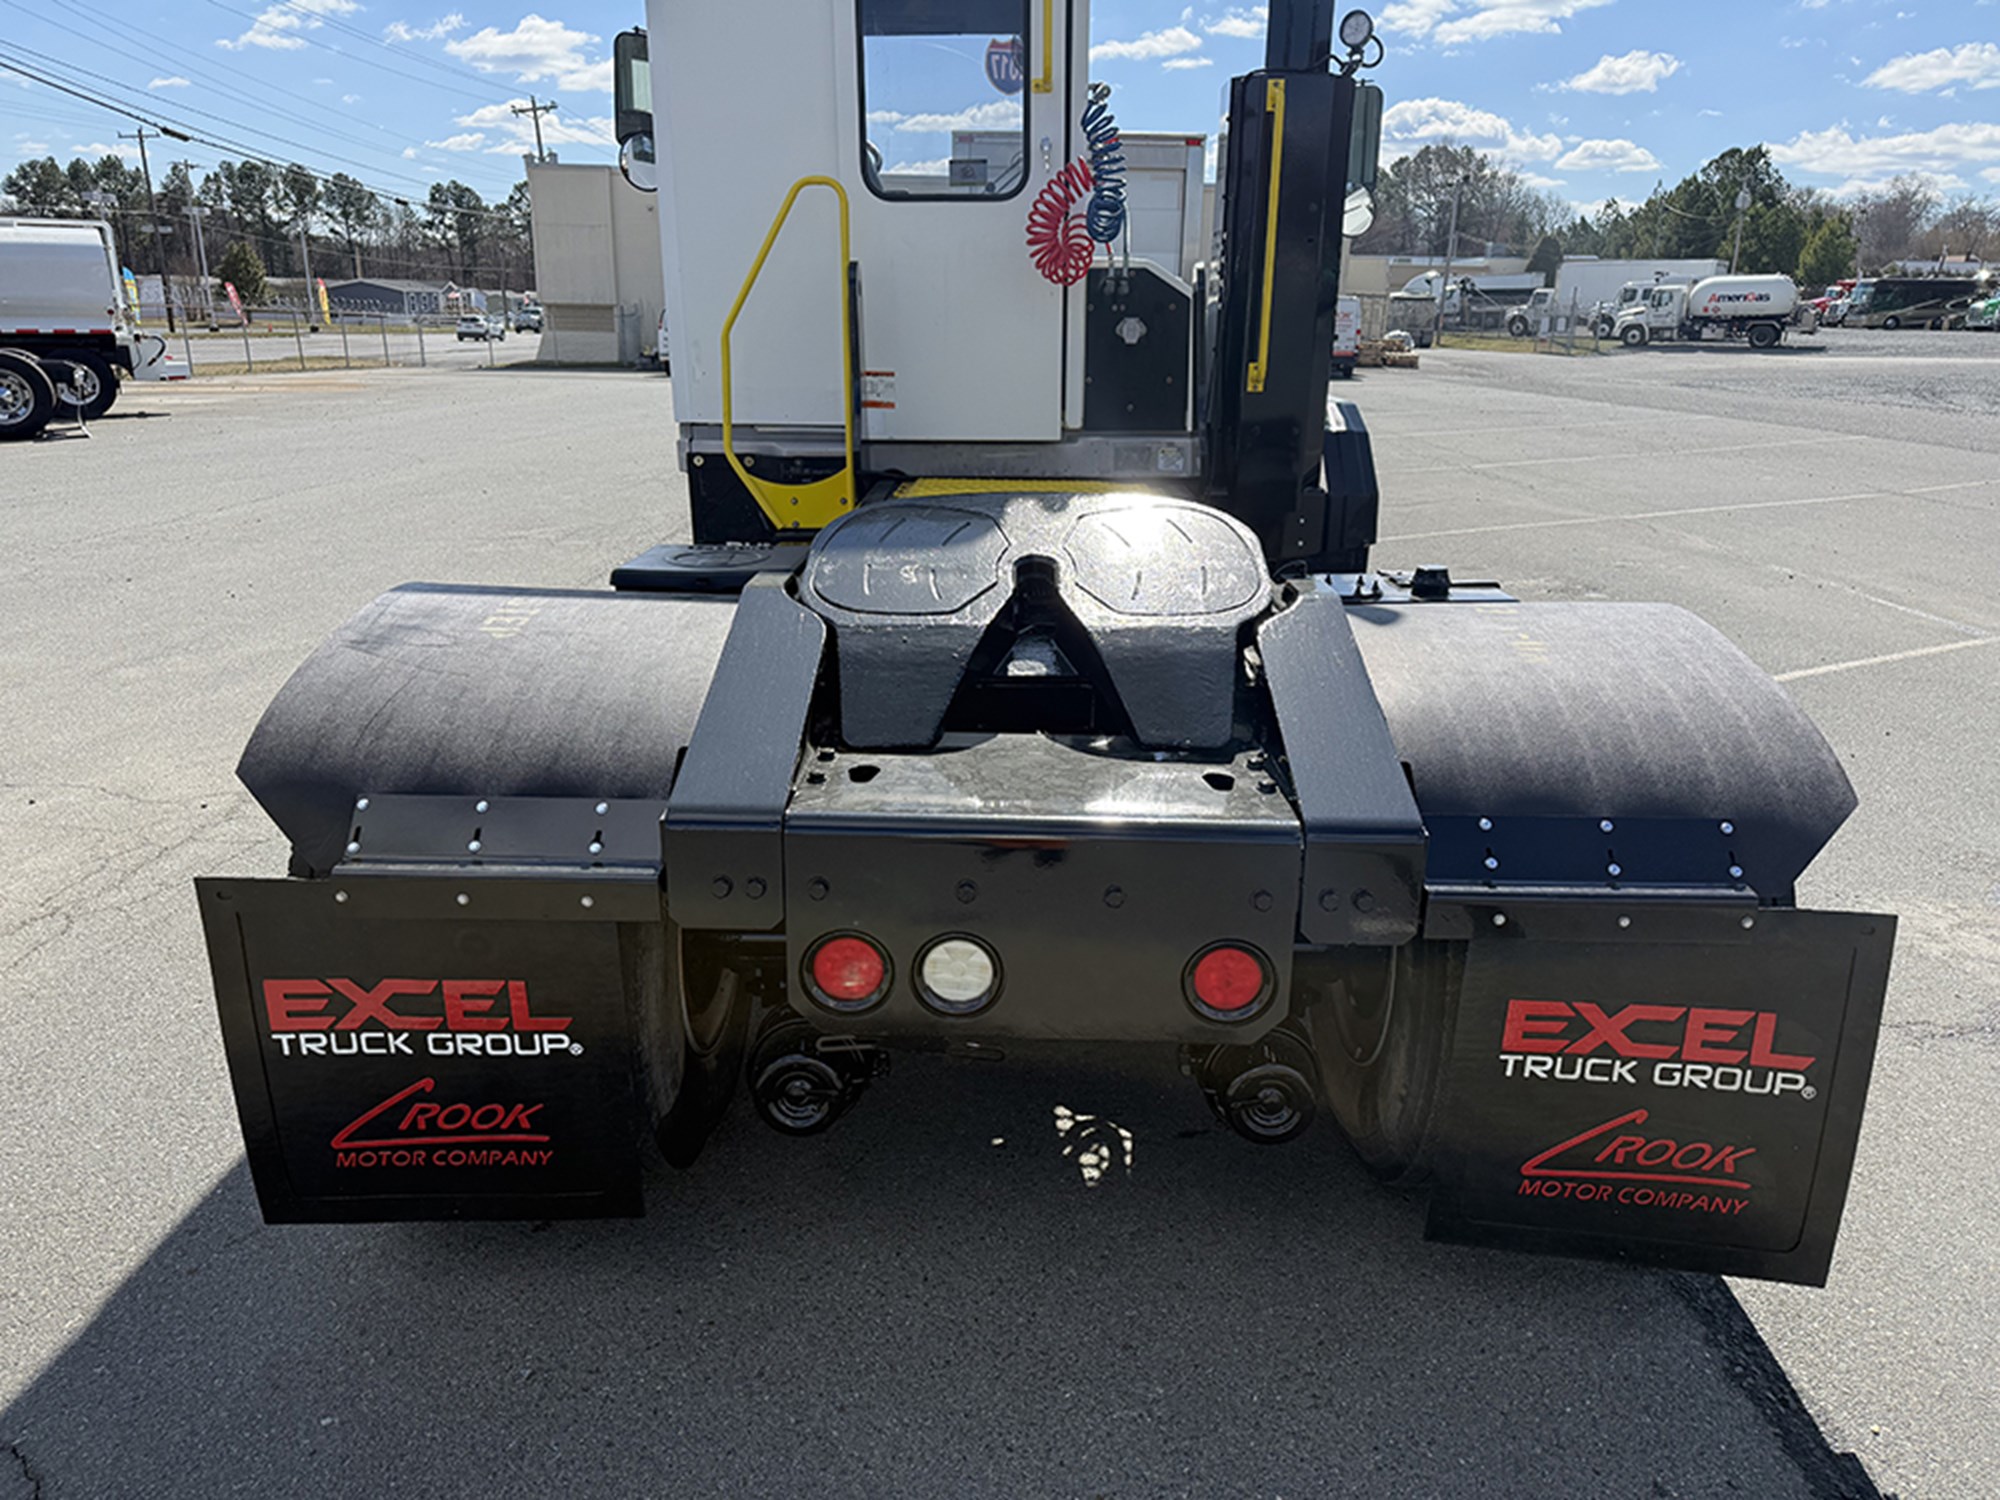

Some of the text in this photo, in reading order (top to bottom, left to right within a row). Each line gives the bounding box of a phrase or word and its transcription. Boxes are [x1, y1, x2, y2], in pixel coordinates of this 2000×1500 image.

[262, 978, 573, 1031] EXCEL
[271, 1032, 414, 1056] TRUCK
[1501, 999, 1816, 1071] EXCEL
[1499, 1054, 1638, 1084] TRUCK
[336, 1149, 554, 1168] MOTOR COMPANY
[1517, 1178, 1750, 1216] MOTOR COMPANY
